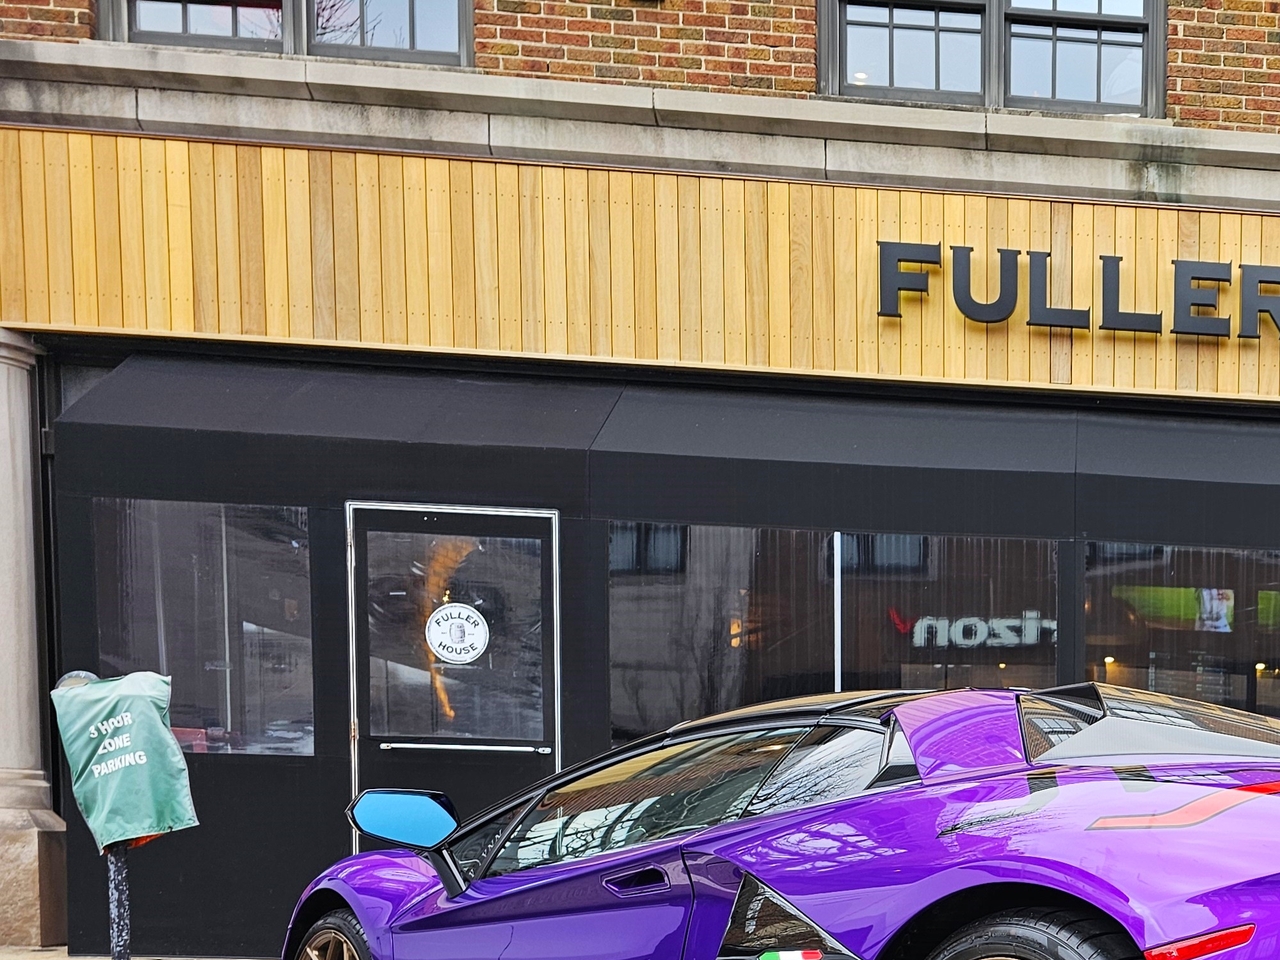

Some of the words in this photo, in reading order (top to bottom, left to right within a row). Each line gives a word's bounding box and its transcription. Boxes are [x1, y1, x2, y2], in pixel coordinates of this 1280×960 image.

[434, 611, 480, 629] FULLER
[437, 641, 478, 656] HOUSE
[88, 725, 98, 738] 3
[97, 711, 133, 735] HOUR
[97, 733, 131, 755] ZONE
[91, 750, 147, 778] PARKING
